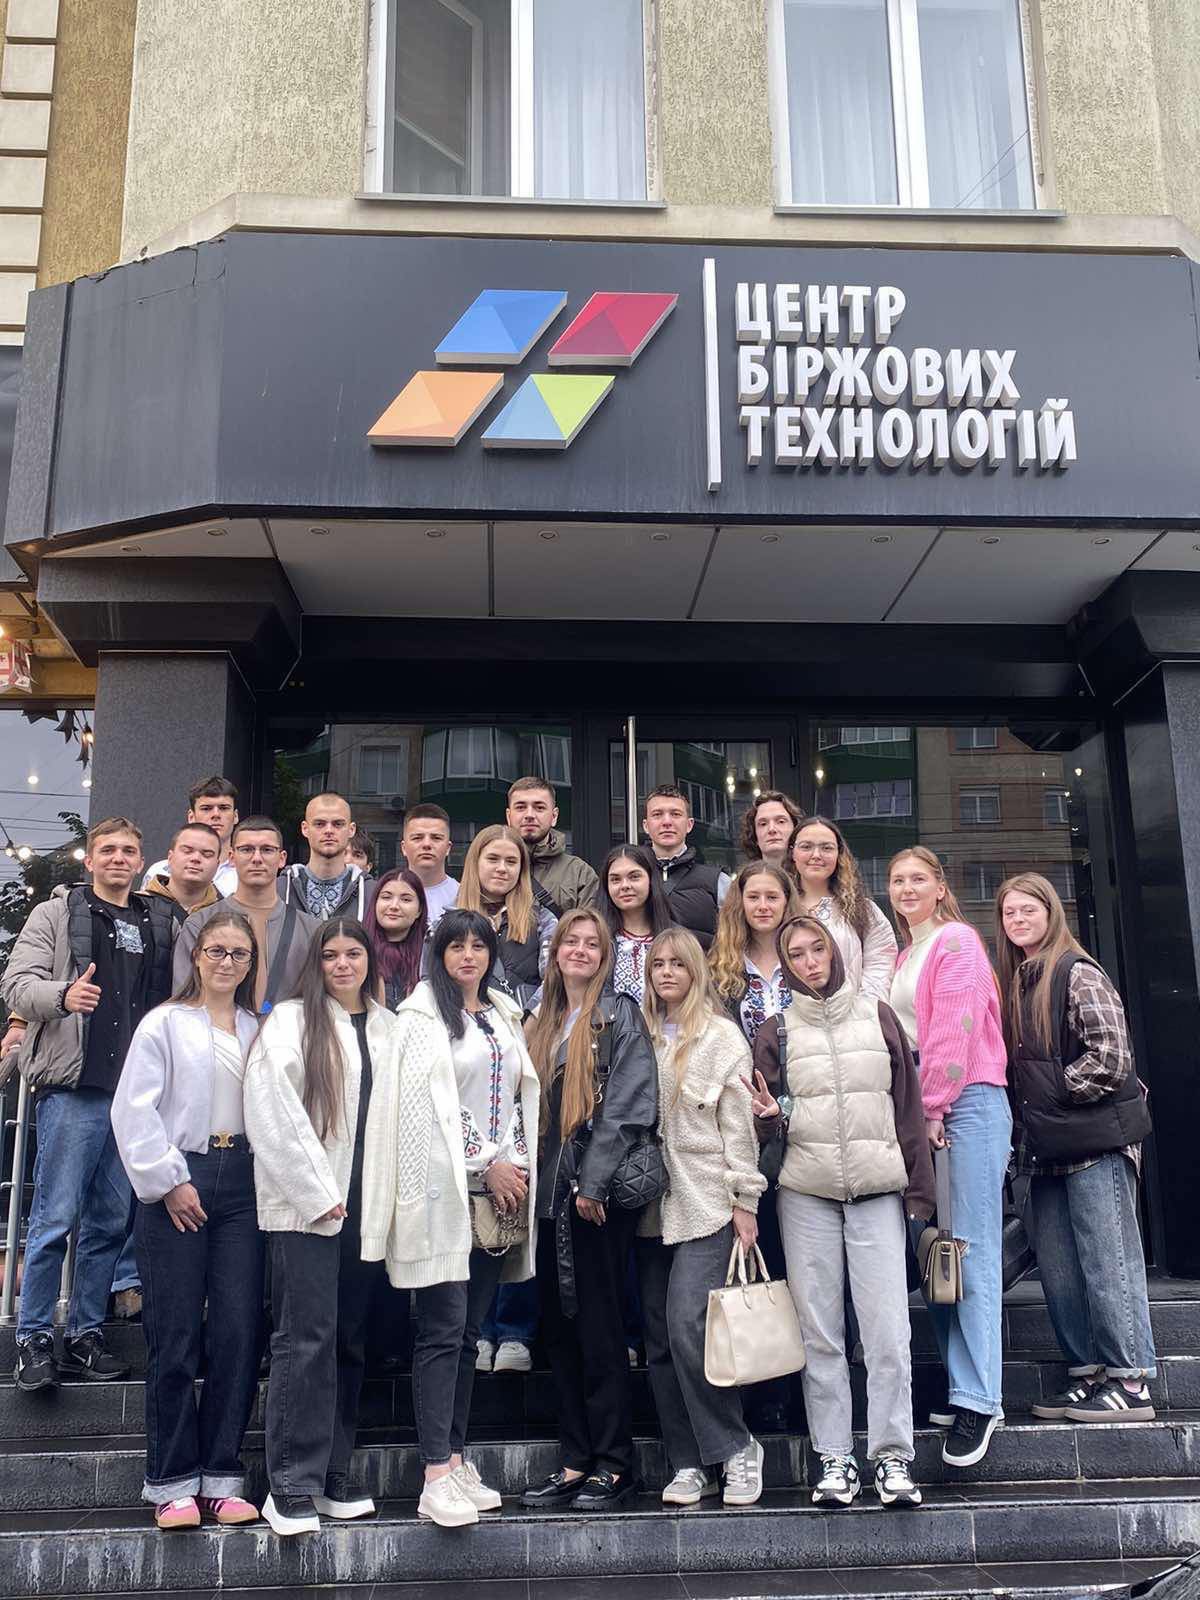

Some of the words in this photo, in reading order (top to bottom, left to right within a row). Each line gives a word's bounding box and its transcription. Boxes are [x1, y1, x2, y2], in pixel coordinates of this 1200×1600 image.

[735, 283, 906, 344] ЦЕНТР
[738, 345, 1021, 407] БІРЖОВИХ
[739, 398, 1077, 469] ТЕХНОЛОГІЙ
